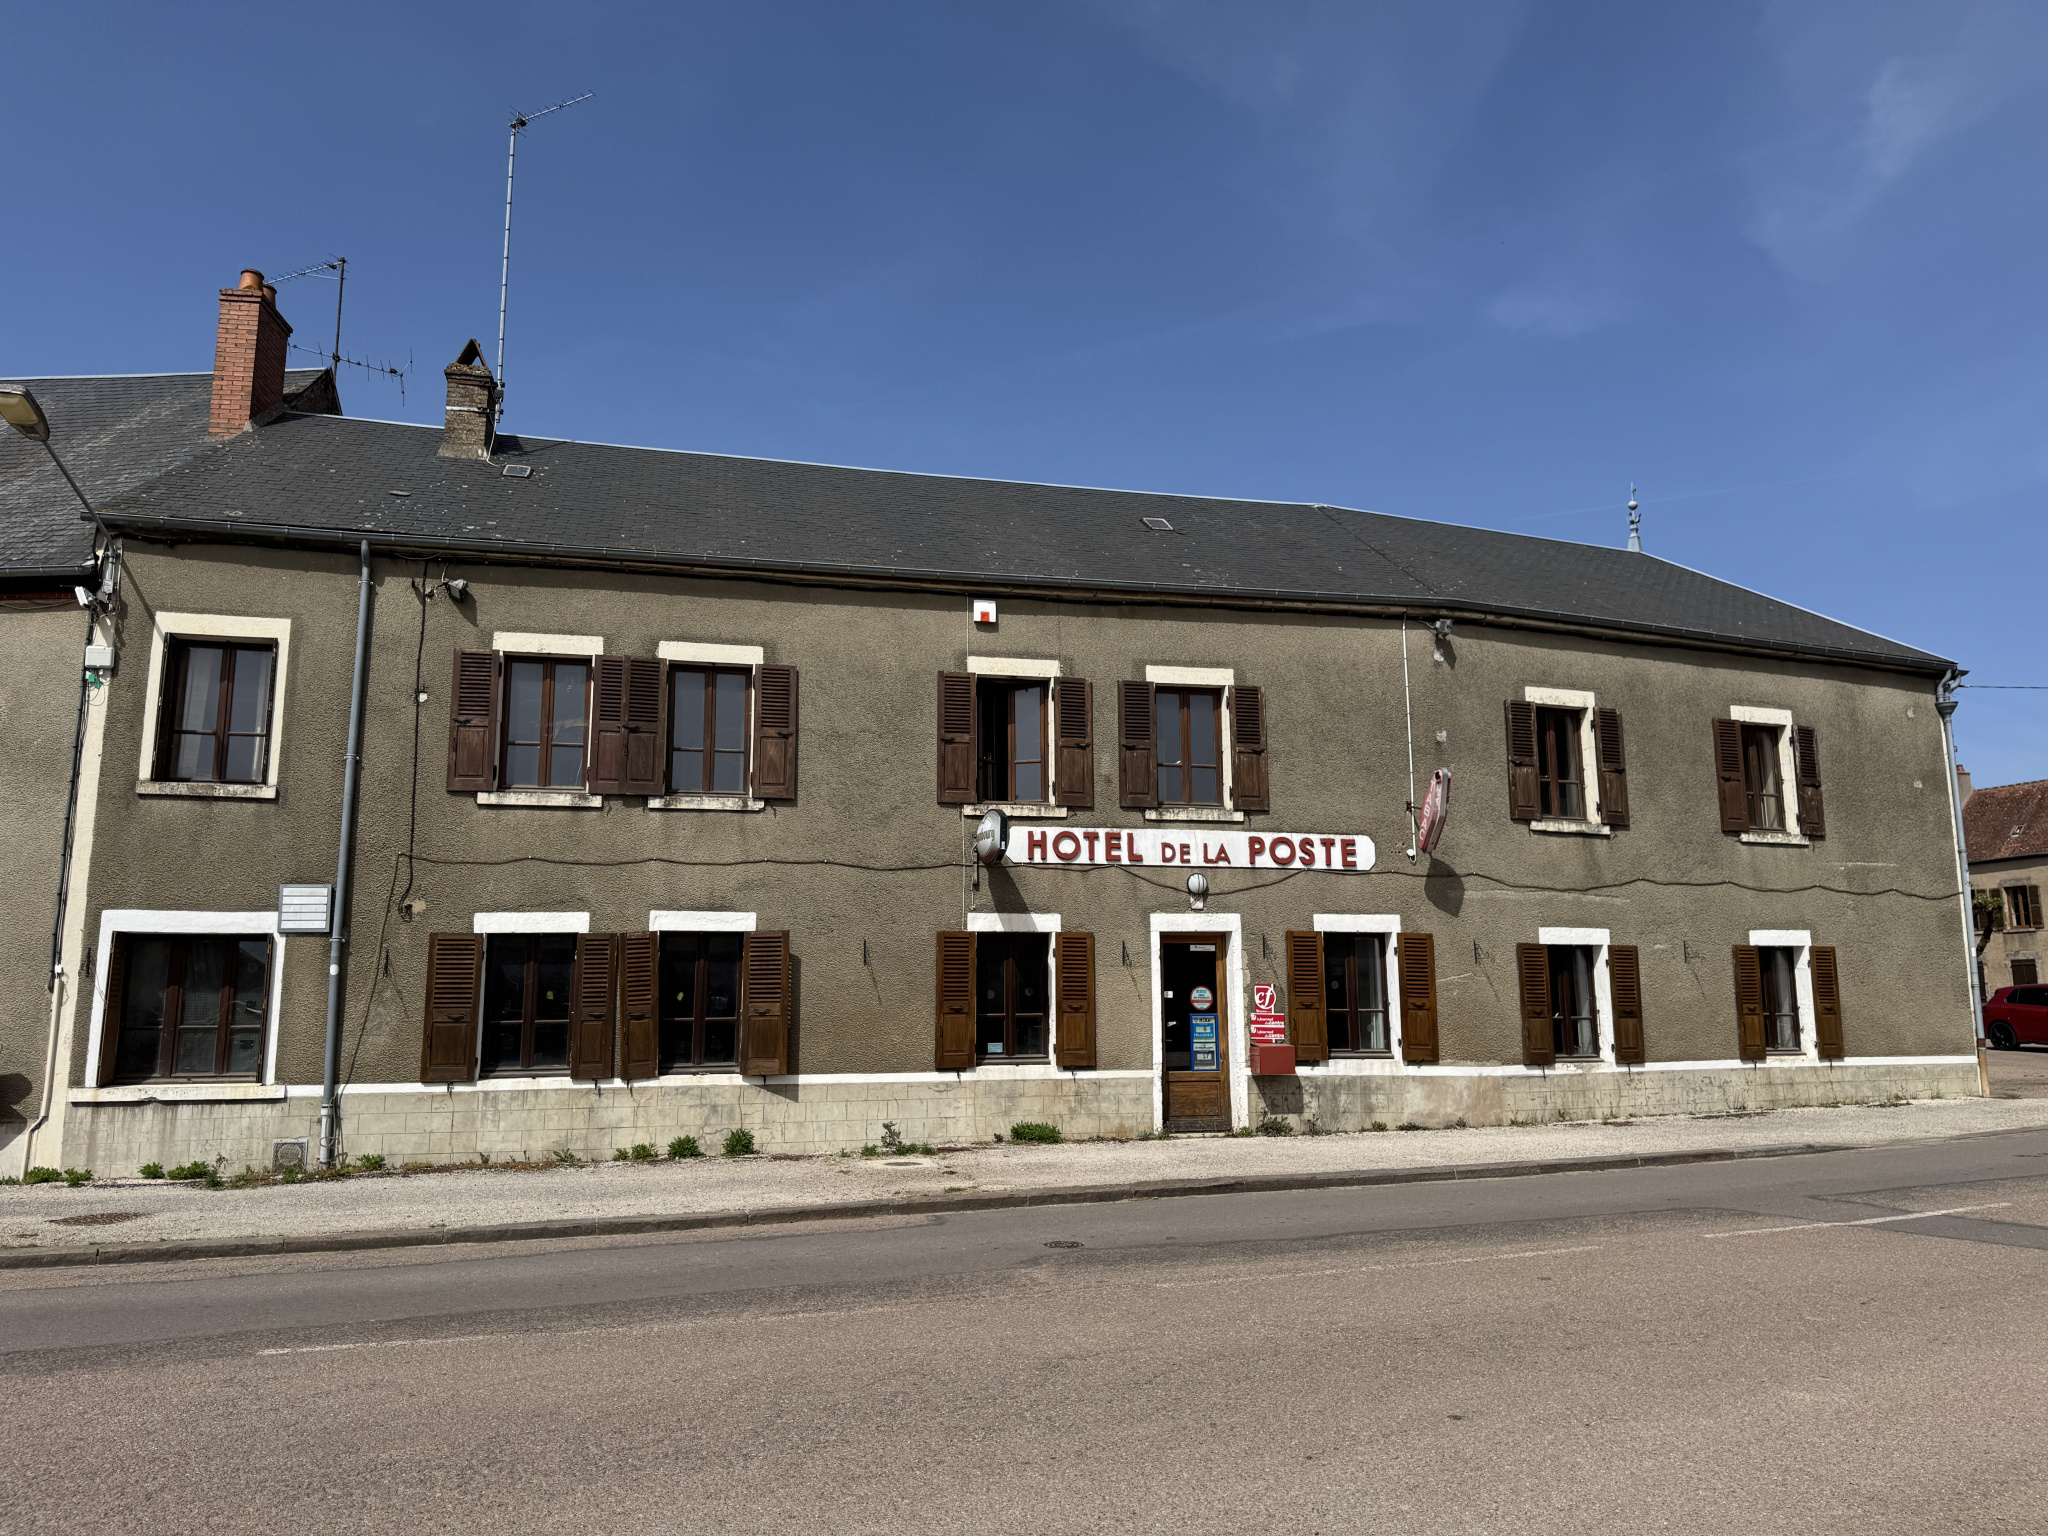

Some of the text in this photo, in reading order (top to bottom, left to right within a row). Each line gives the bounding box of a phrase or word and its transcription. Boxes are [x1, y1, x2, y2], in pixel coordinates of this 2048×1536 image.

[1419, 780, 1436, 840] TABAC
[1027, 830, 1357, 867] HOTEL DE LA POSTE
